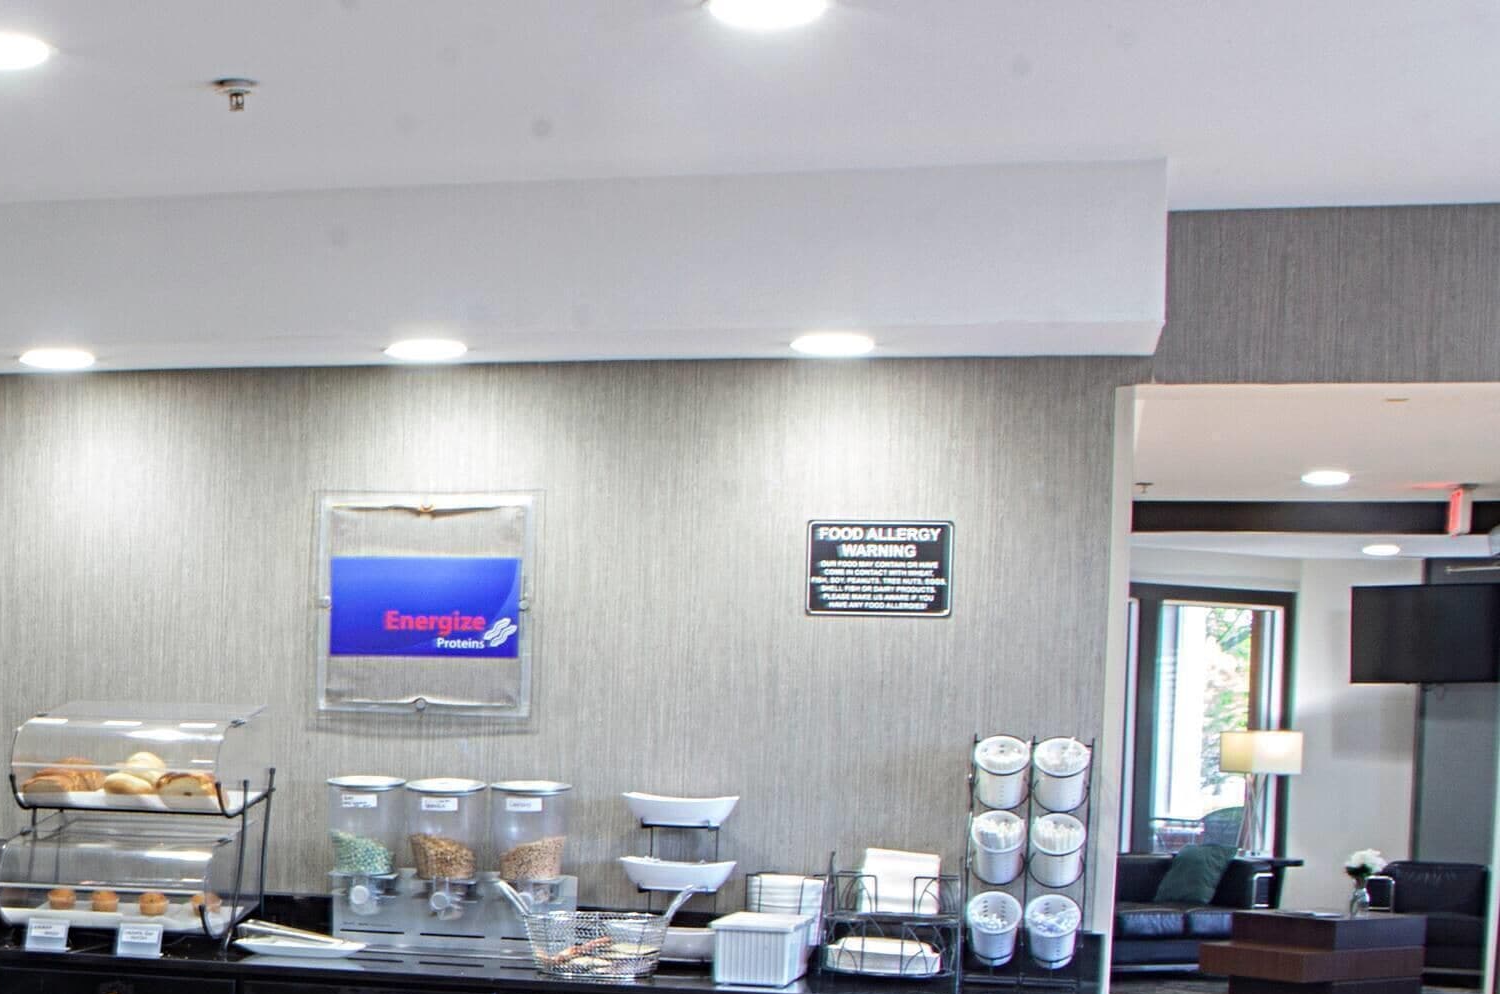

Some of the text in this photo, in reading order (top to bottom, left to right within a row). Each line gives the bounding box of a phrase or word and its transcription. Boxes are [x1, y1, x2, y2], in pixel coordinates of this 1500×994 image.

[819, 526, 942, 541] FOOD ALLERGY
[840, 543, 917, 558] WARNING
[384, 610, 486, 637] Energize
[436, 637, 485, 649] Proteins
